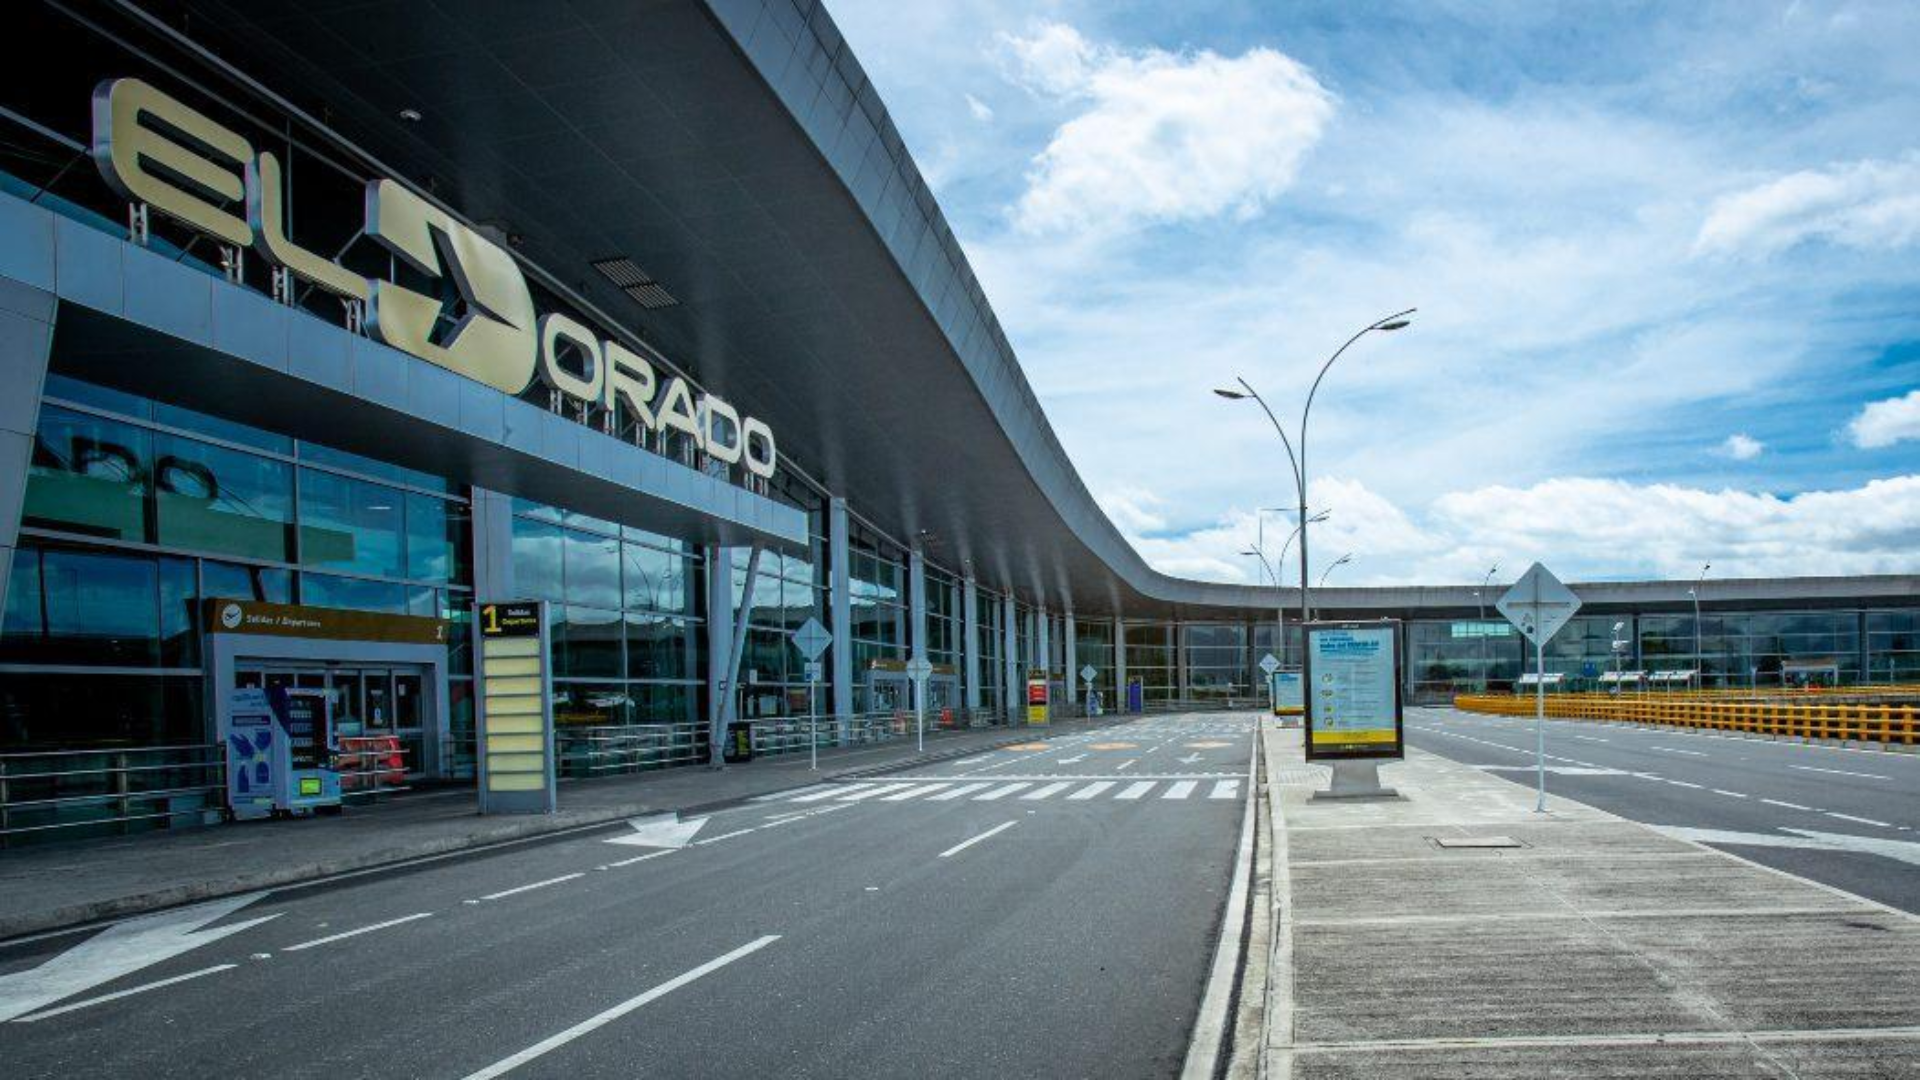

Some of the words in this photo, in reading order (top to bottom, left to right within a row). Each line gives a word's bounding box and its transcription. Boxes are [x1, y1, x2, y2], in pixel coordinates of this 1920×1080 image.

[93, 77, 368, 300] EL
[366, 178, 777, 479] DORADO
[482, 604, 502, 633] 1
